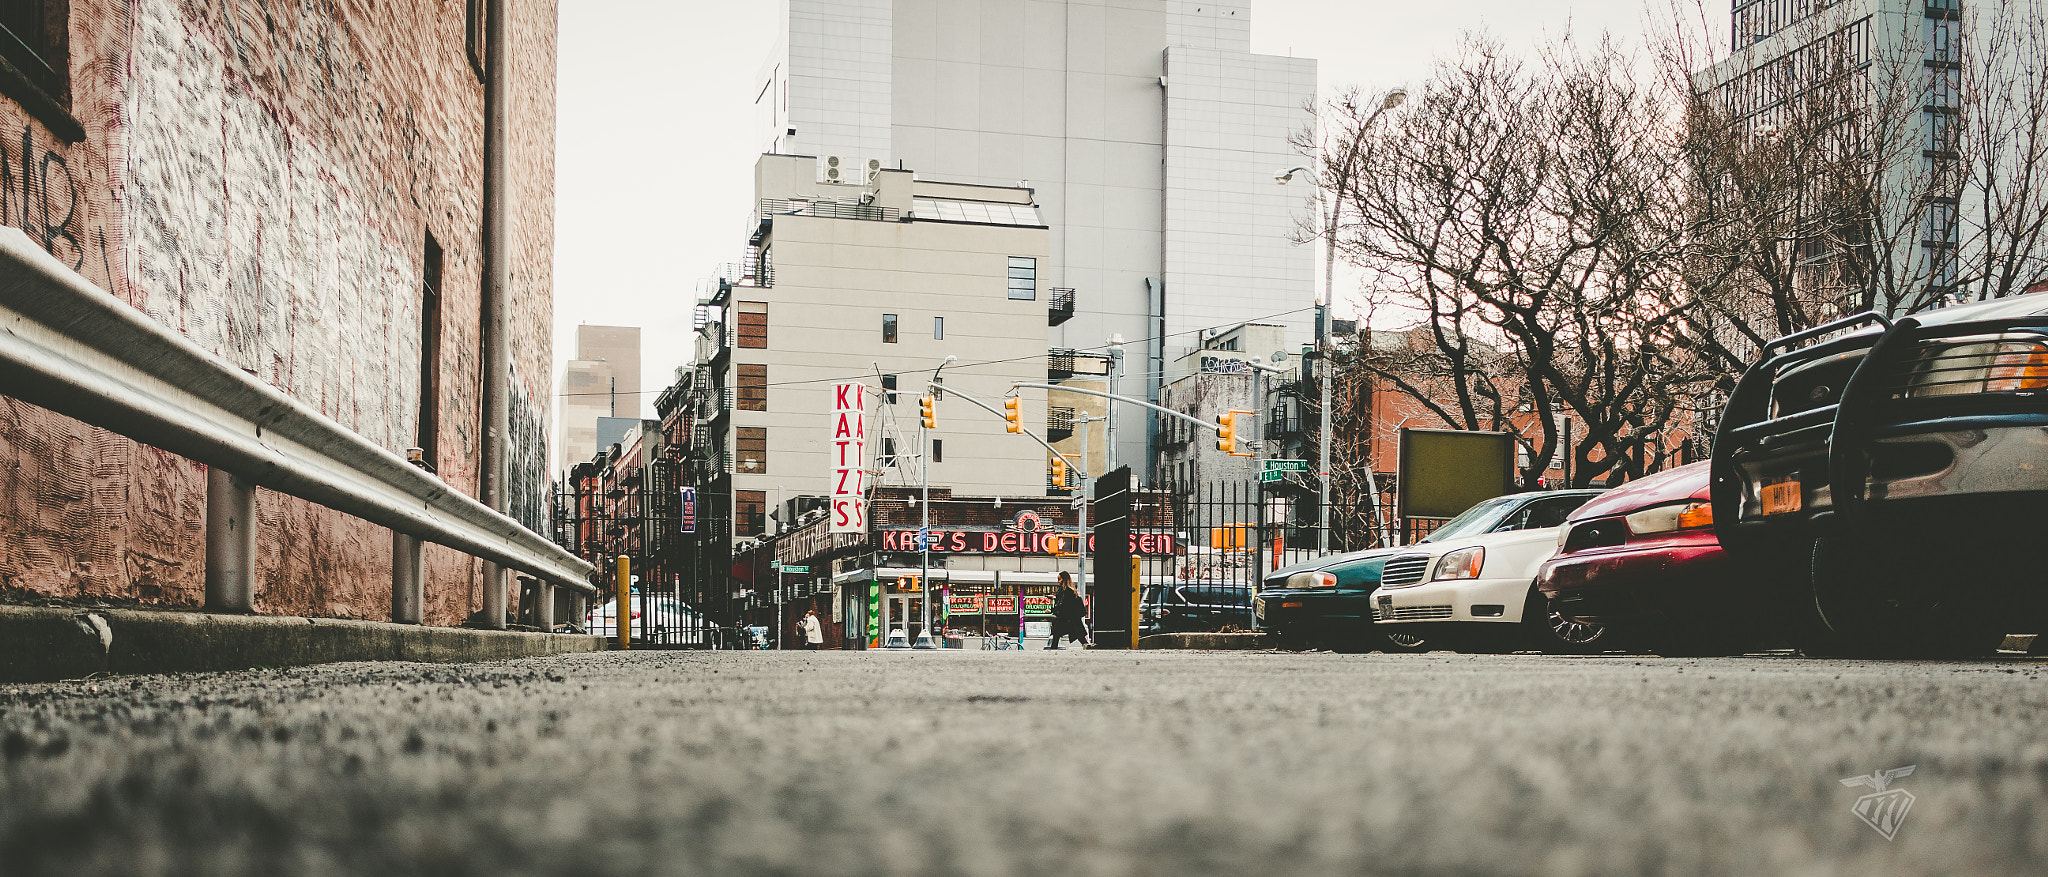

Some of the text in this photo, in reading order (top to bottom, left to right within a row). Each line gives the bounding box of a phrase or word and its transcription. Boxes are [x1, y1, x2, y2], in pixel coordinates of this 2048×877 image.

[833, 384, 851, 527] KATZ'S
[855, 384, 864, 528] KATZ'S
[1264, 472, 1269, 481] E
[1270, 460, 1299, 470] Houston
